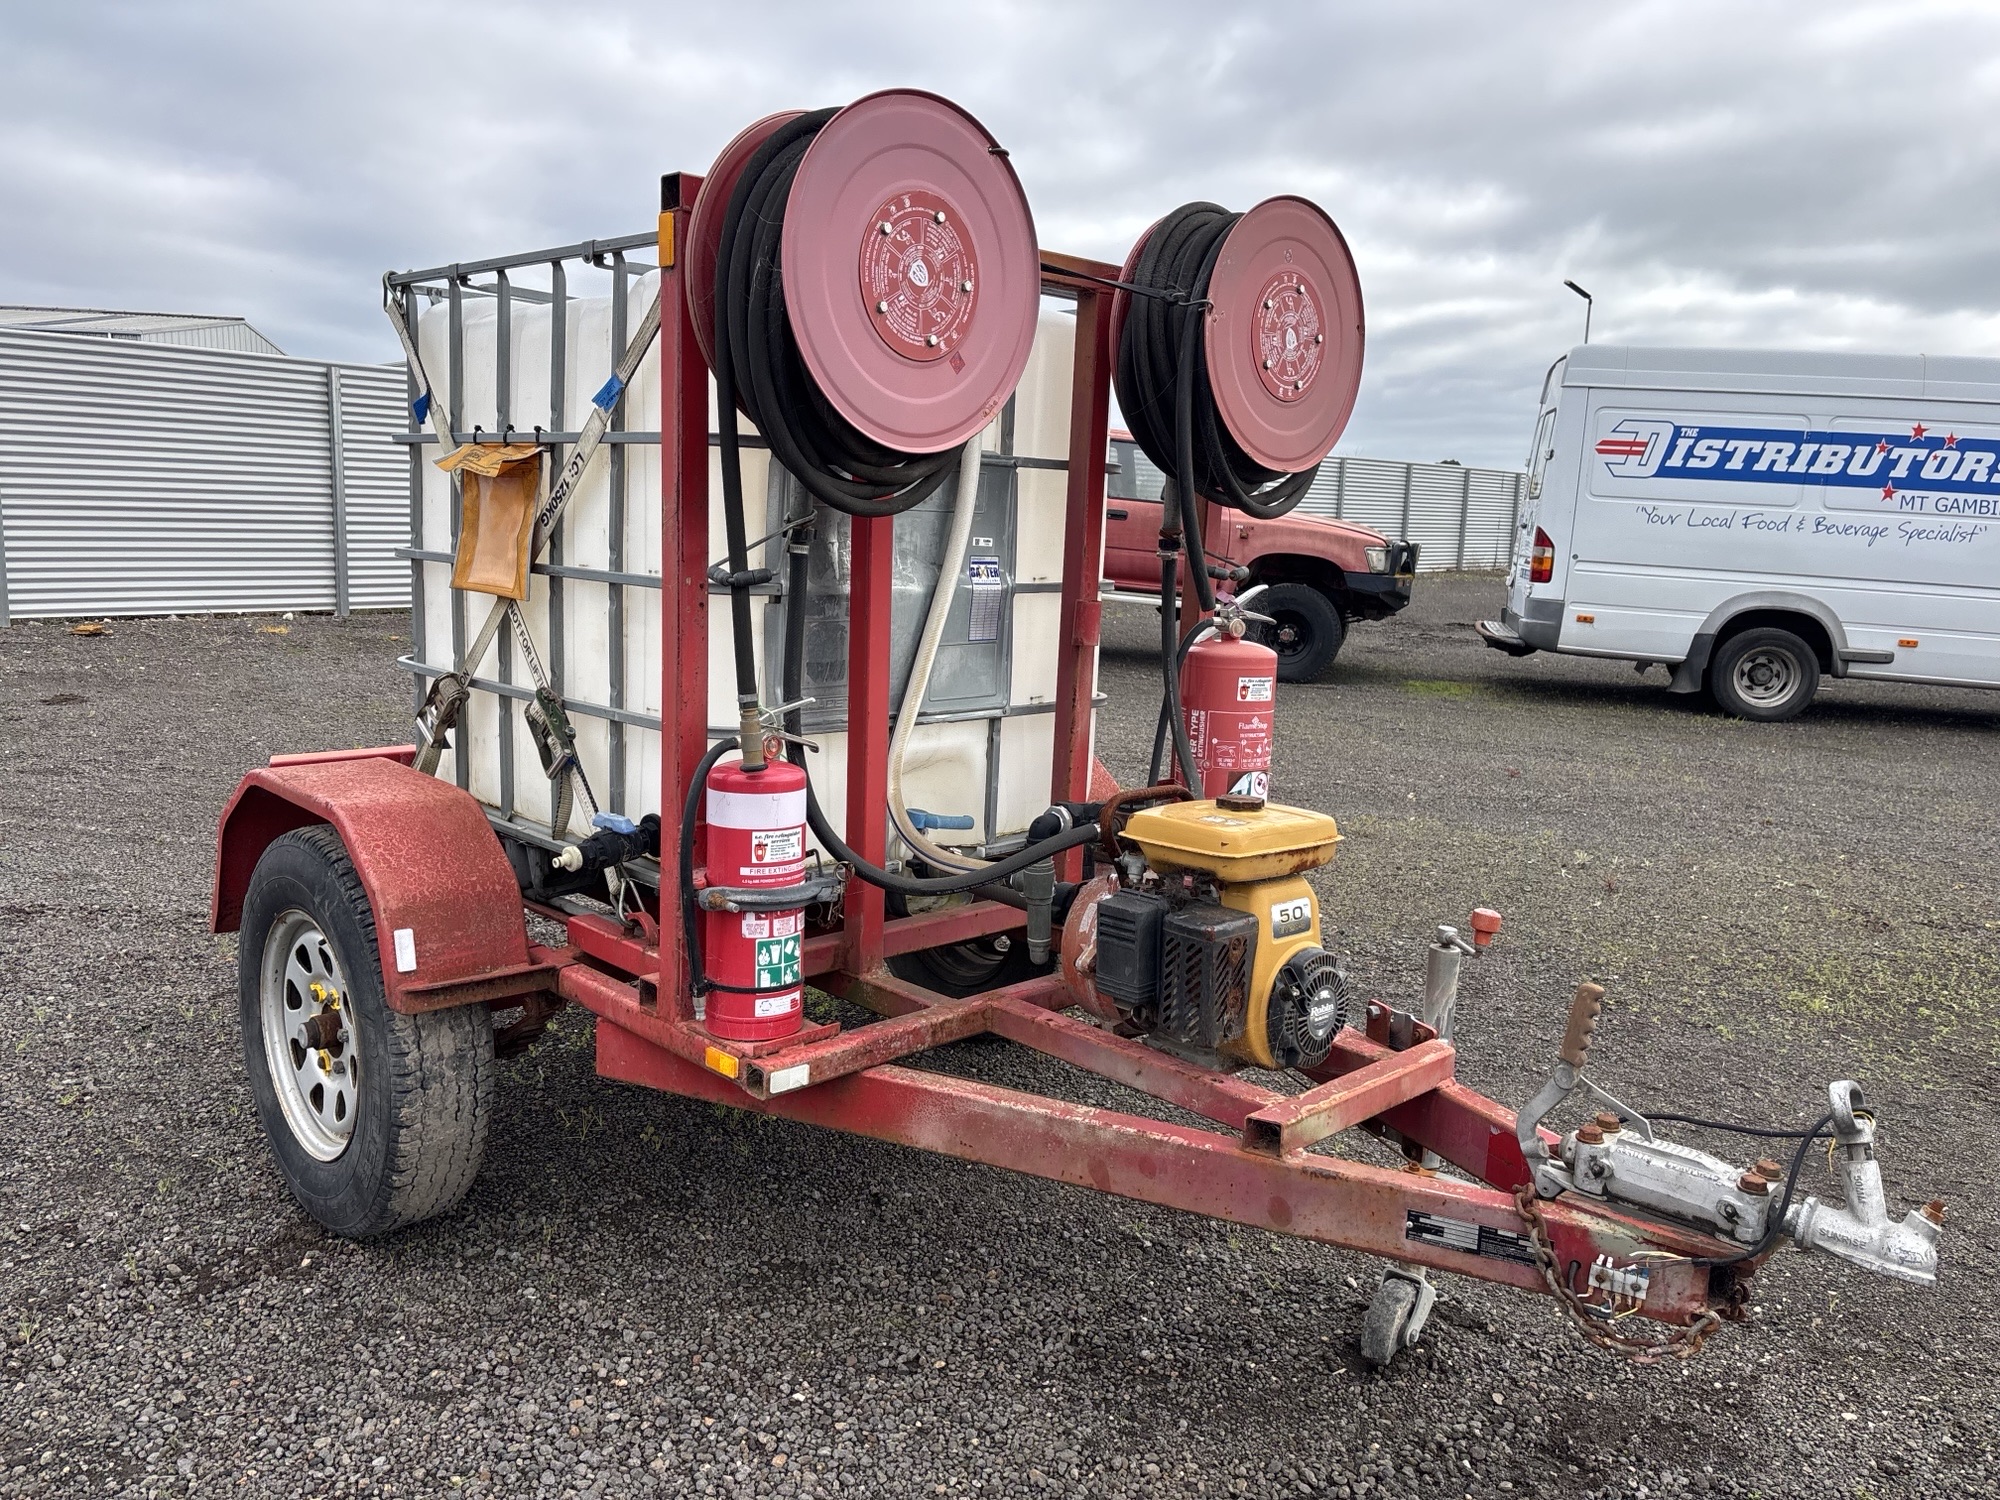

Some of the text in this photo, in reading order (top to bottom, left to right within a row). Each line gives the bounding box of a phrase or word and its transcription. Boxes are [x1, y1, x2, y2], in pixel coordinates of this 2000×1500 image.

[1680, 427, 1699, 438] THE
[540, 478, 571, 528] 1250KG
[1899, 495, 2000, 516] MT GAMBI
[1687, 510, 1733, 530] Local
[1742, 514, 1788, 533] Food
[1796, 515, 1805, 532] &
[1814, 519, 1888, 549] Beverage
[508, 603, 523, 629] NOT
[519, 630, 534, 659] FOR
[1190, 709, 1200, 736] TYPE
[1197, 710, 1206, 758] EXTINGUISHER
[1279, 906, 1303, 924] 5.0
[1310, 1003, 1335, 1017] Robin
[1818, 1227, 1867, 1250] SUNRISE
